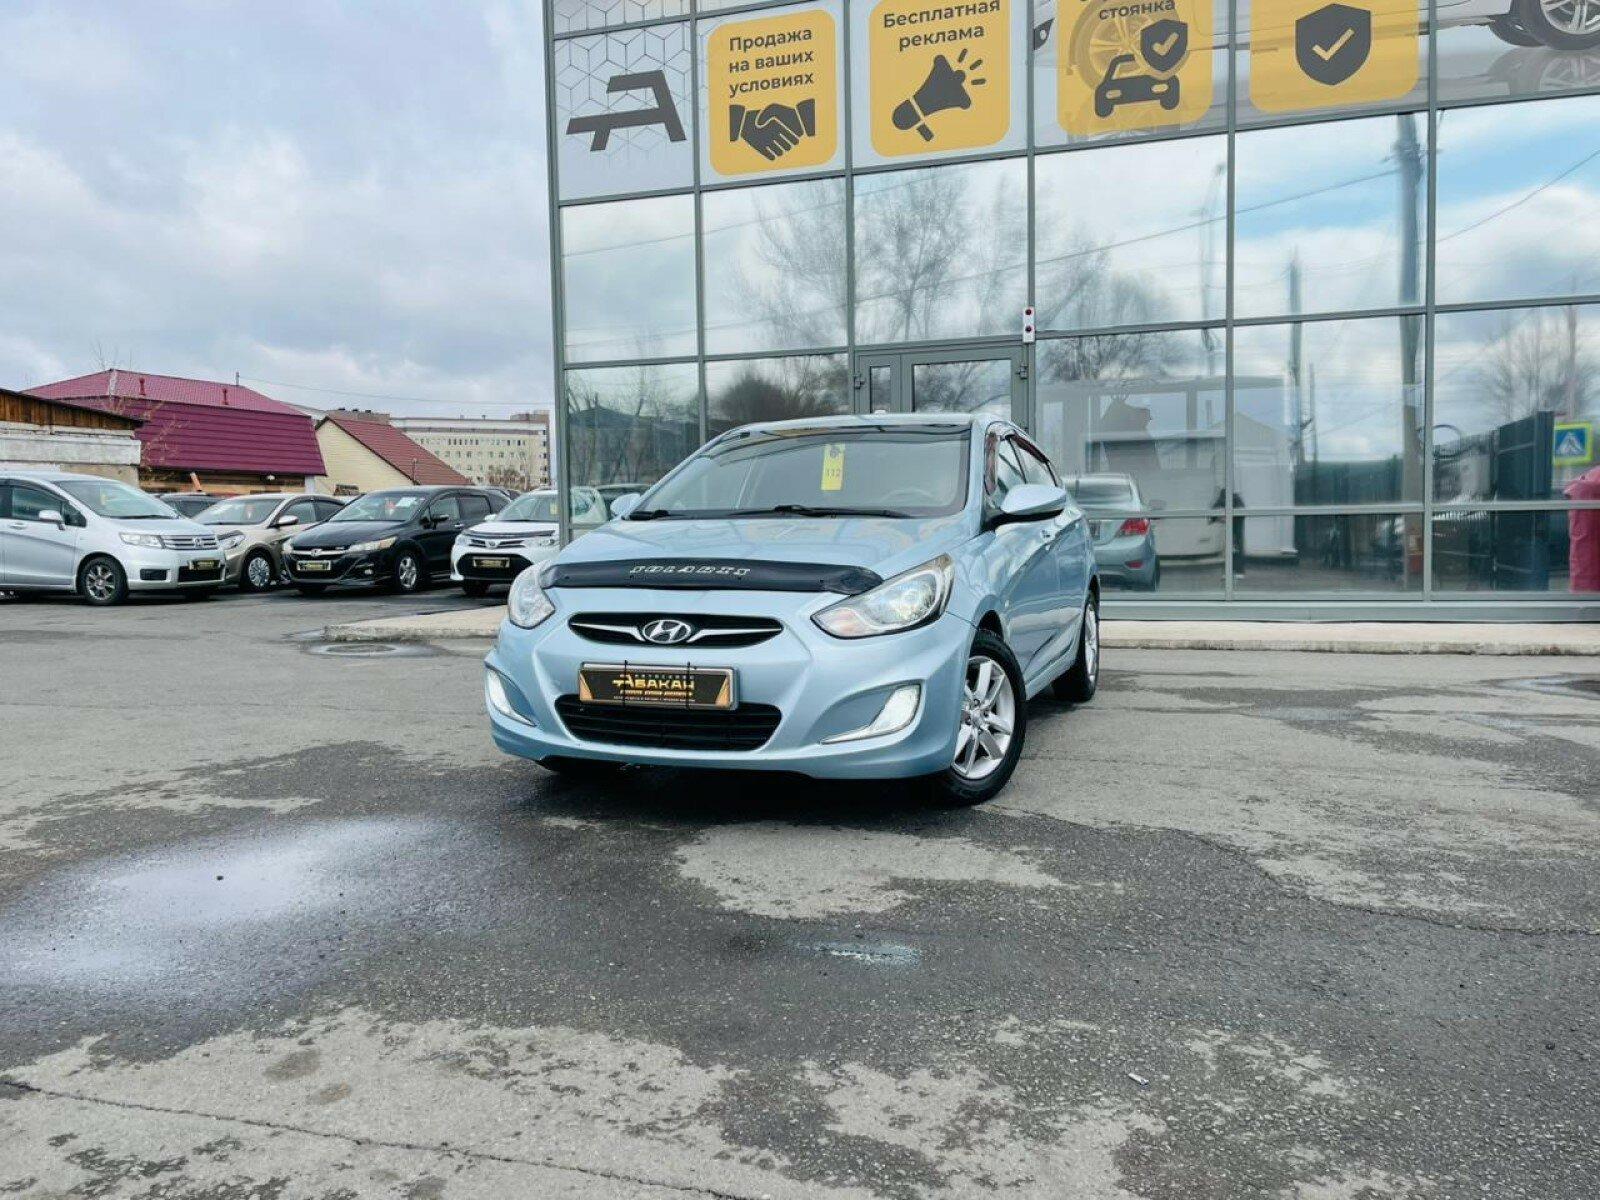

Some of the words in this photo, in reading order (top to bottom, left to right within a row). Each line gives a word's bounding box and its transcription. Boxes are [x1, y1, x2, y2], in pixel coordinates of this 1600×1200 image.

[884, 0, 1000, 28] Бесплатная
[1099, 0, 1175, 20] стоянка
[729, 29, 812, 52] Продажа
[899, 25, 985, 51] реклама
[729, 60, 750, 73] на
[755, 50, 814, 69] ваших
[729, 73, 815, 98] условиях
